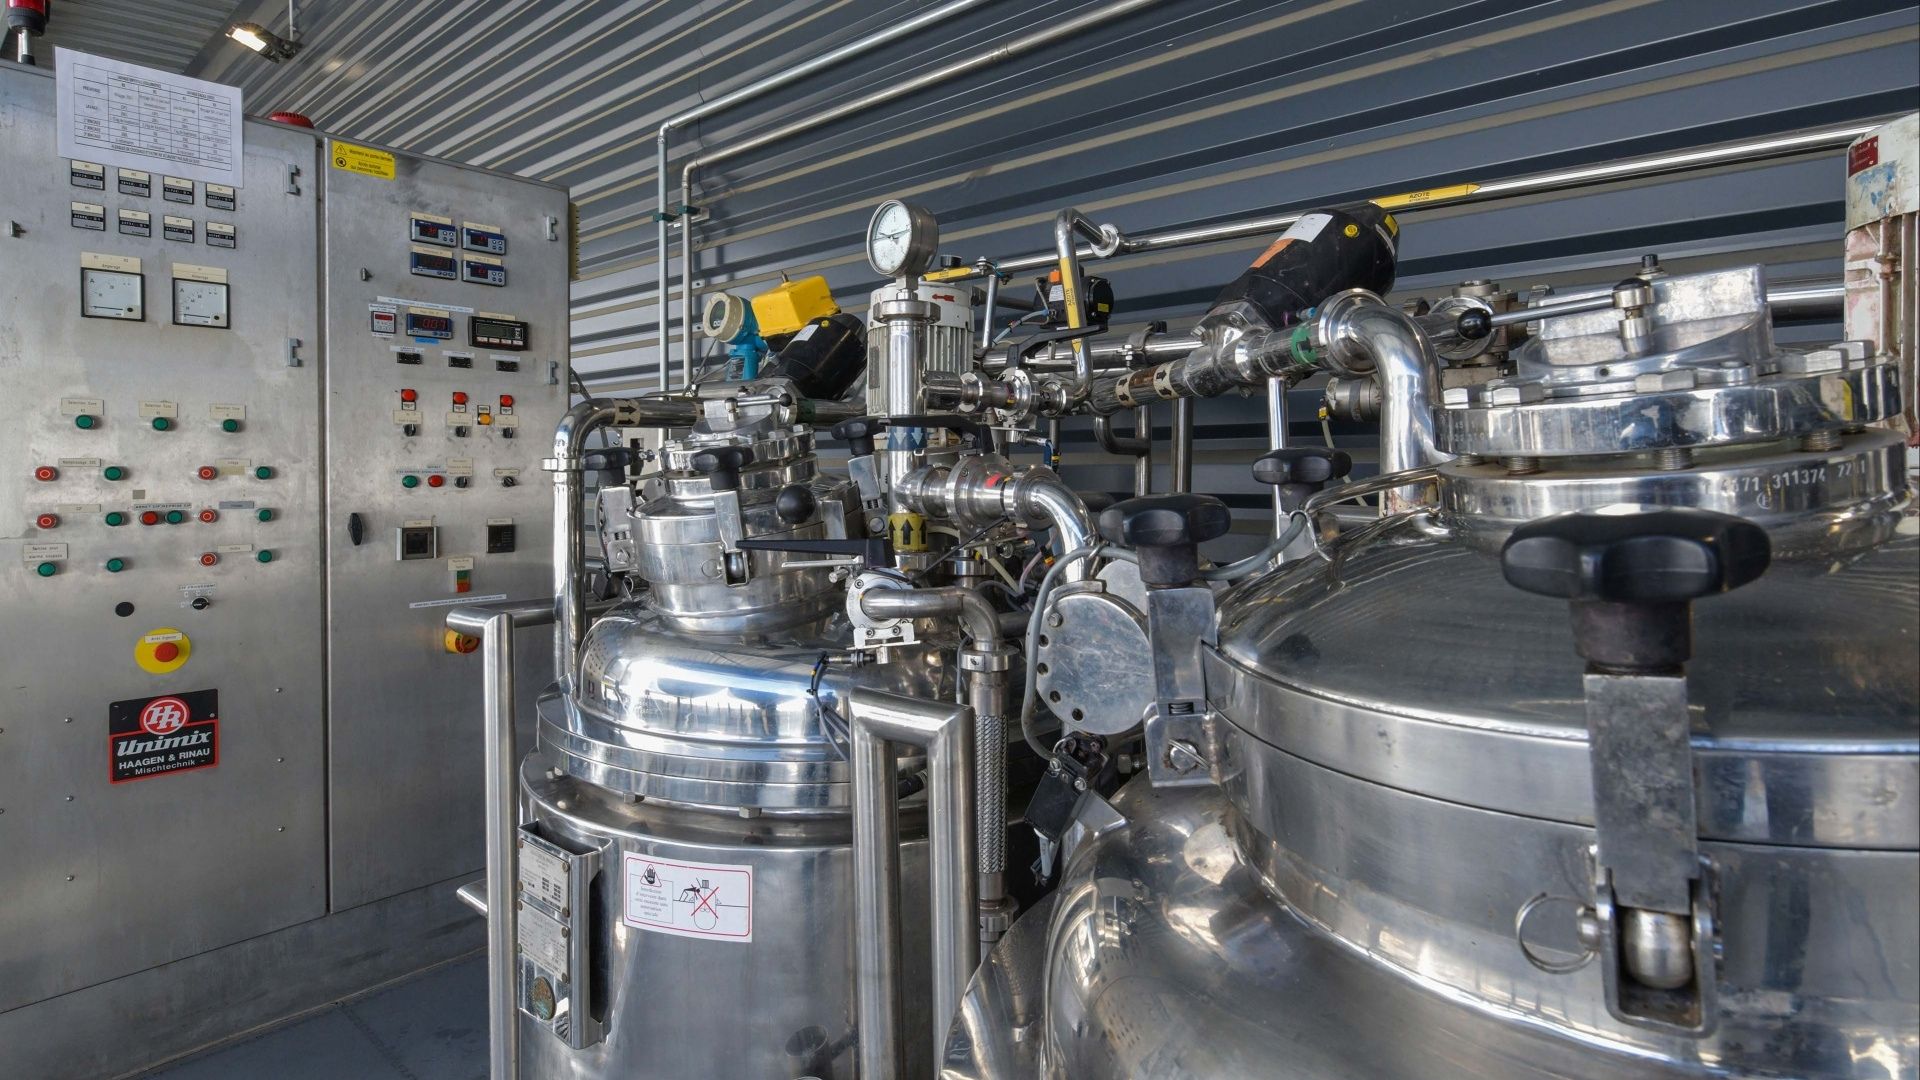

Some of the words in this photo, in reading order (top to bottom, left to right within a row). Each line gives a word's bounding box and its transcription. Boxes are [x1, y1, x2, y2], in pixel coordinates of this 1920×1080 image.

[1772, 467, 1826, 489] 311374
[117, 730, 212, 757] Unimix
[118, 755, 165, 770] HAAGEN
[168, 753, 176, 762] &
[179, 748, 211, 760] RINAU
[134, 759, 196, 775] Mischtechnik
